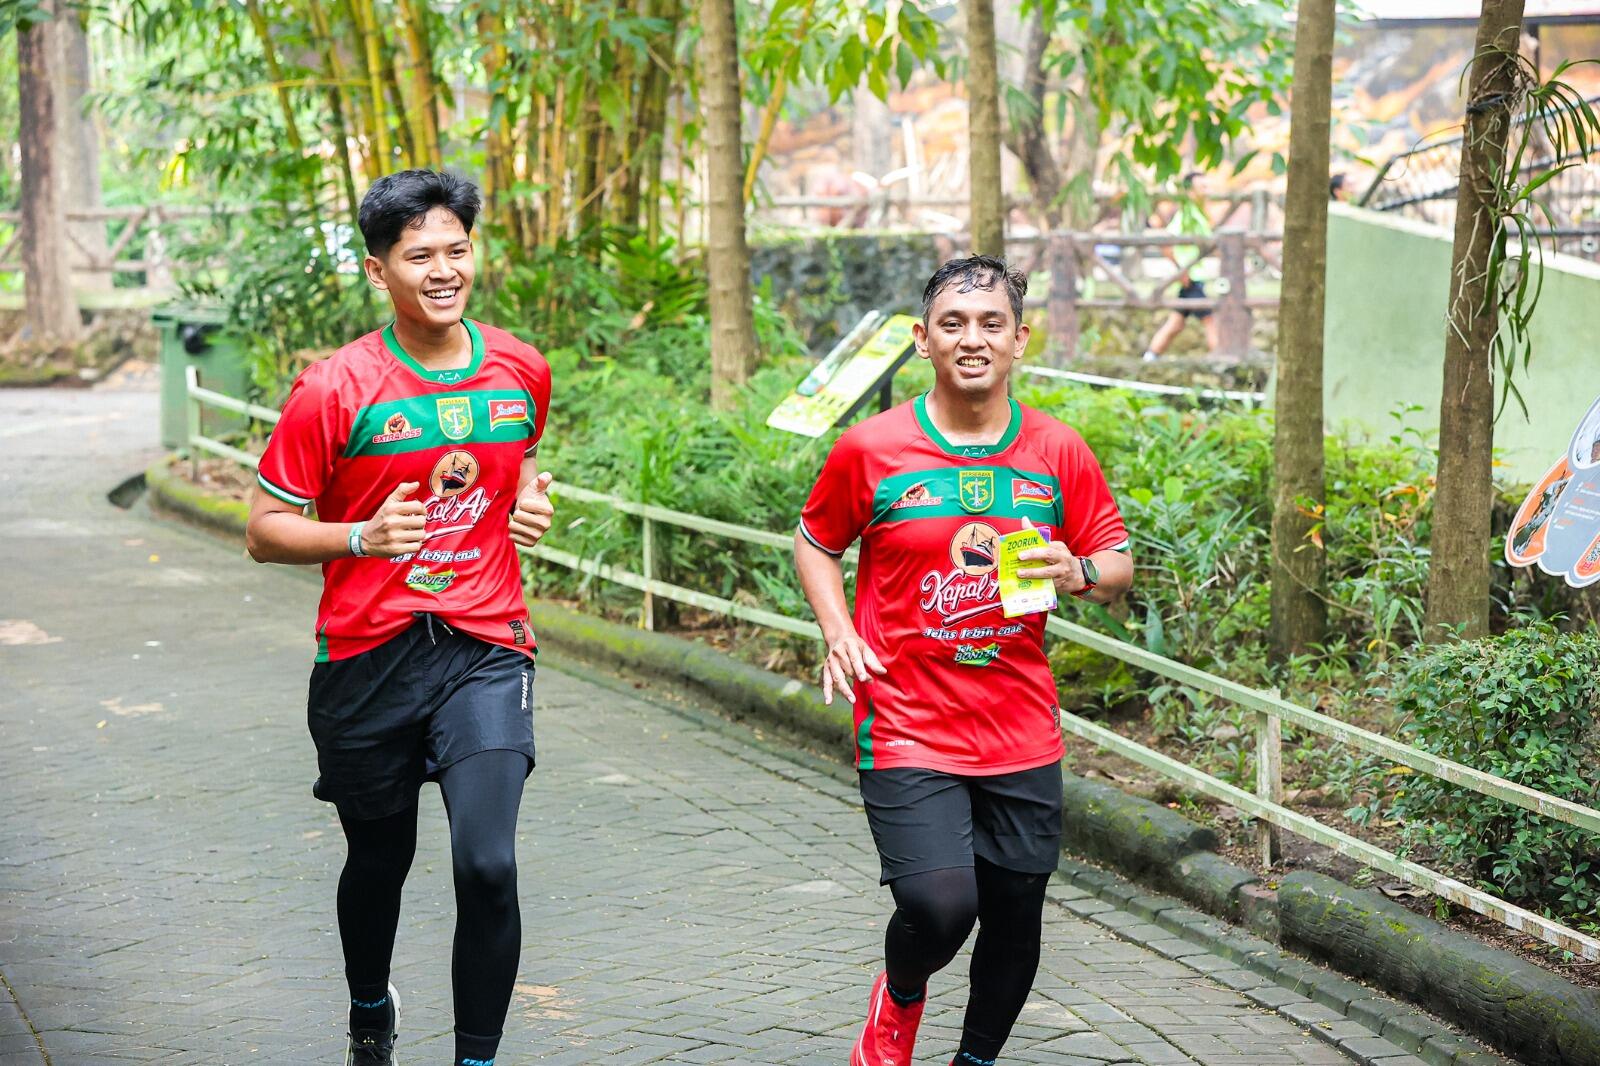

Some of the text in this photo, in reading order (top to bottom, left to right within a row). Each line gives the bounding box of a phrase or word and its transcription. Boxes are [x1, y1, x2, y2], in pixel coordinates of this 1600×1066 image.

[1007, 536, 1040, 551] ZOORUN
[417, 547, 454, 562] lebih
[454, 547, 481, 562] enak
[920, 569, 990, 617] Kapal
[923, 626, 957, 640] Jelas
